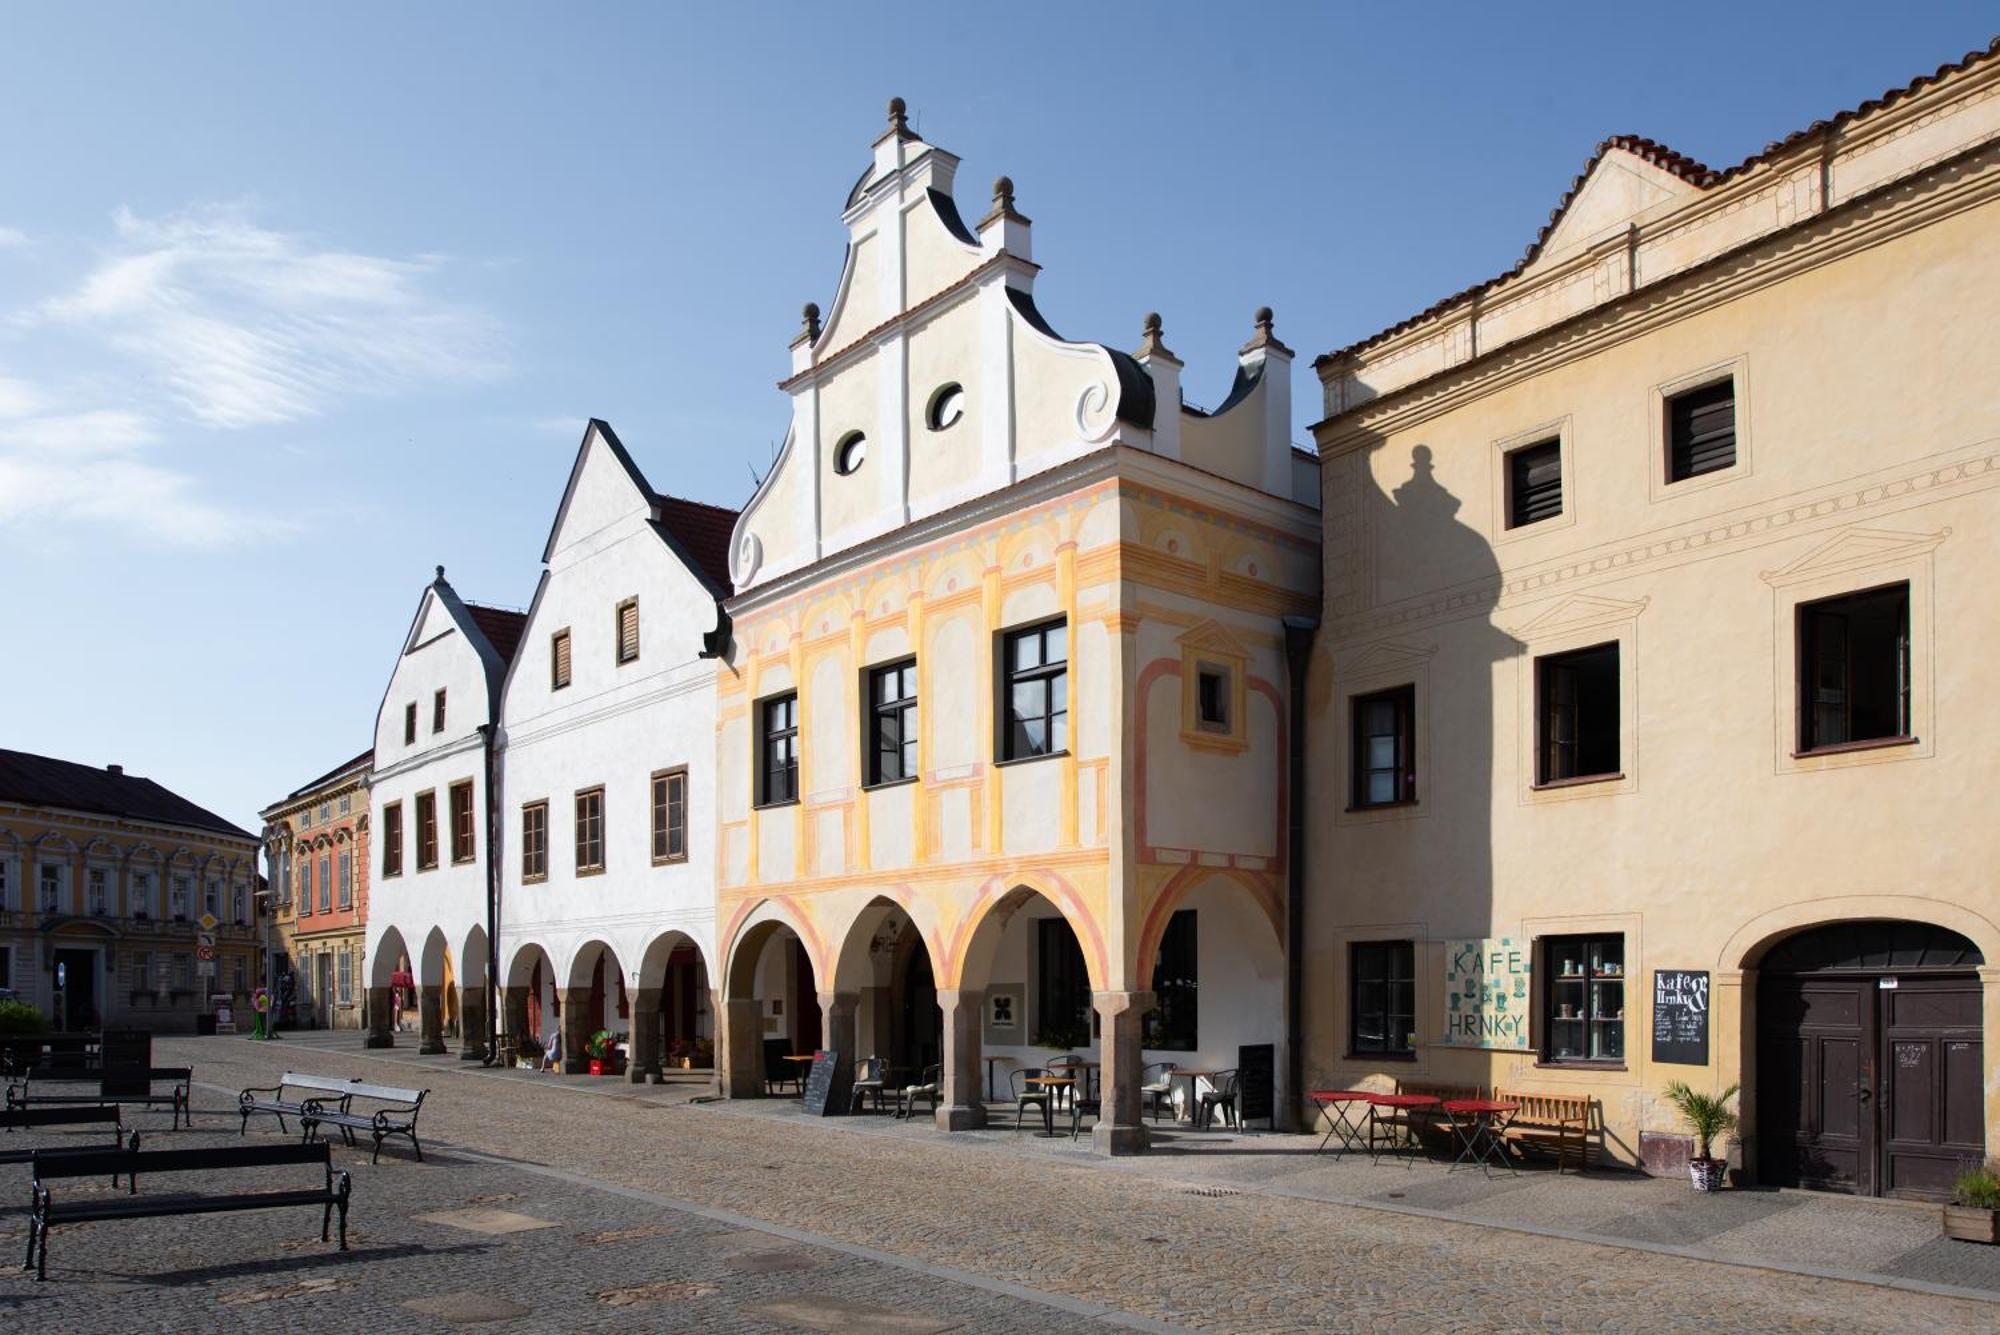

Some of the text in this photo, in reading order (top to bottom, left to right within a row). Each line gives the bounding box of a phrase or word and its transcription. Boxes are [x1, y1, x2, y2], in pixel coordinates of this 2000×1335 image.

[1454, 952, 1521, 974] KAFE
[1482, 985, 1492, 1002] &
[1656, 973, 1708, 1012] Kafe &
[1449, 1014, 1523, 1036] HRNKY
